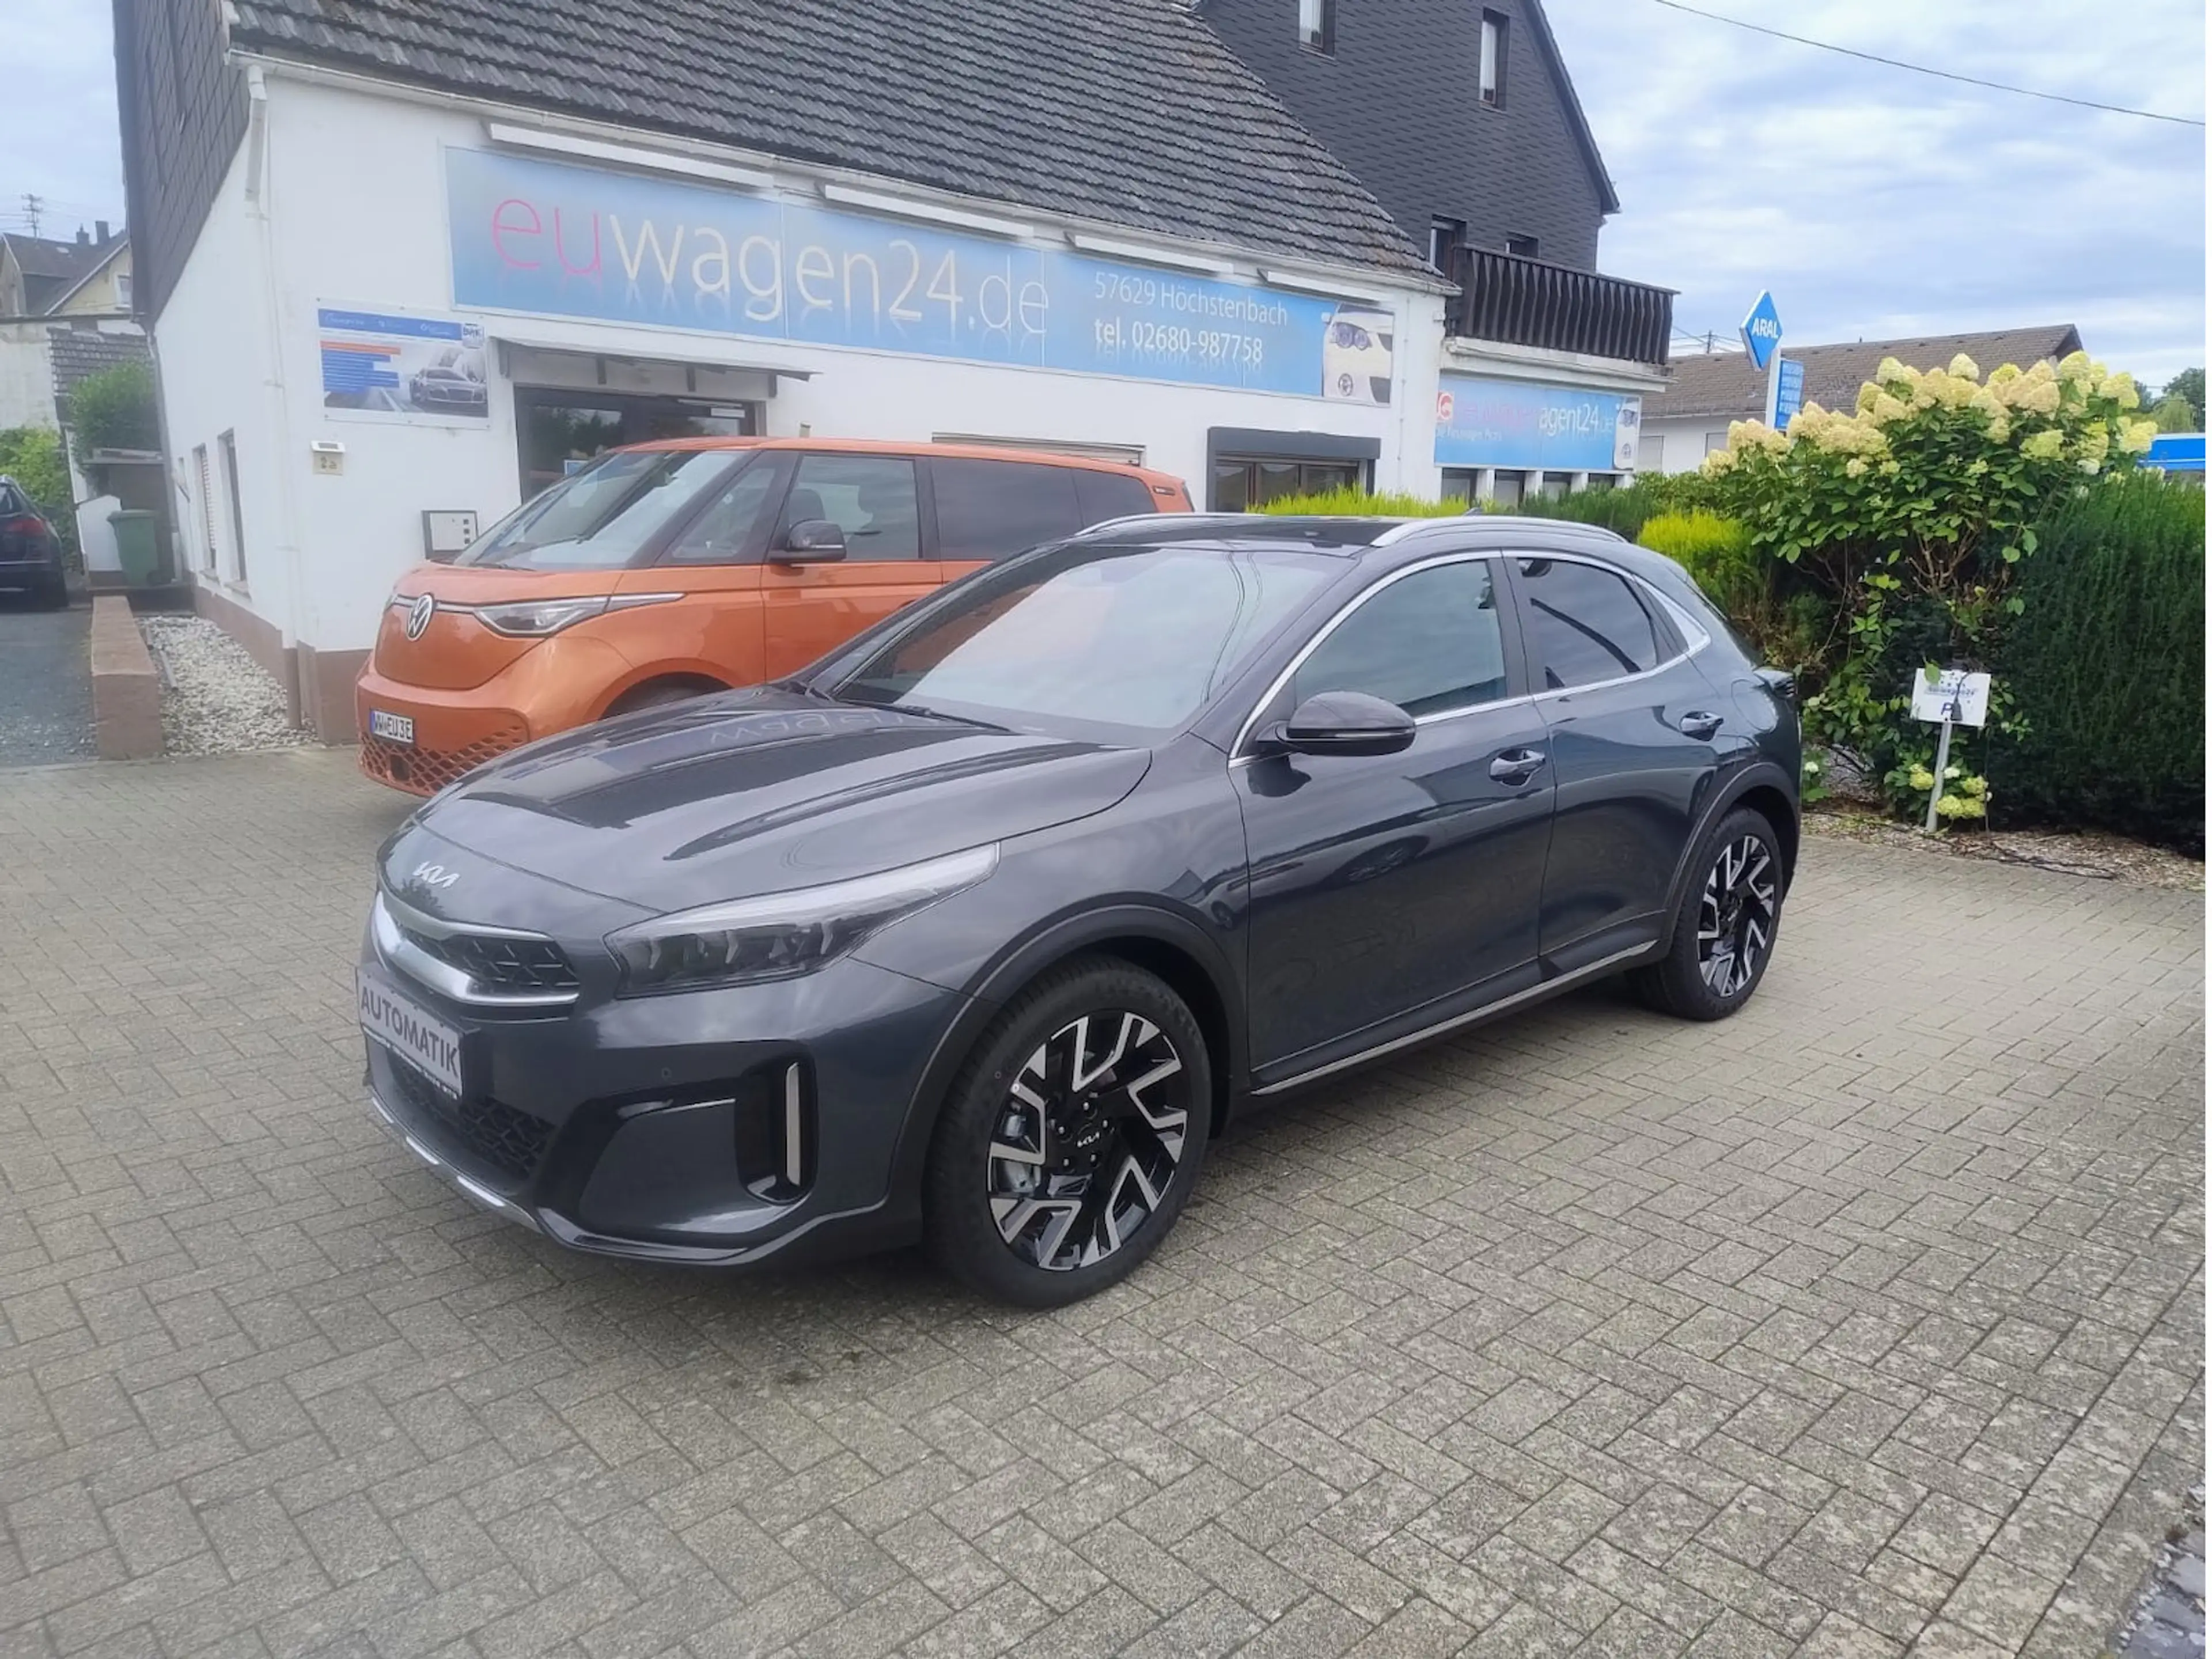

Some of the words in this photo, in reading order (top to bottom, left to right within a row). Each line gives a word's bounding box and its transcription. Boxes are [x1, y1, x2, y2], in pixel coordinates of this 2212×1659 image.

[491, 199, 1049, 334] euwagen24.de
[1094, 271, 1156, 305] 57629
[1161, 286, 1288, 327] Höchstenbach
[1094, 317, 1126, 347] tel.
[1132, 321, 1263, 363] 02680-987758
[1751, 317, 1779, 339] ARAL
[412, 861, 461, 888] KIA
[361, 986, 459, 1078] AUTOMATIK
